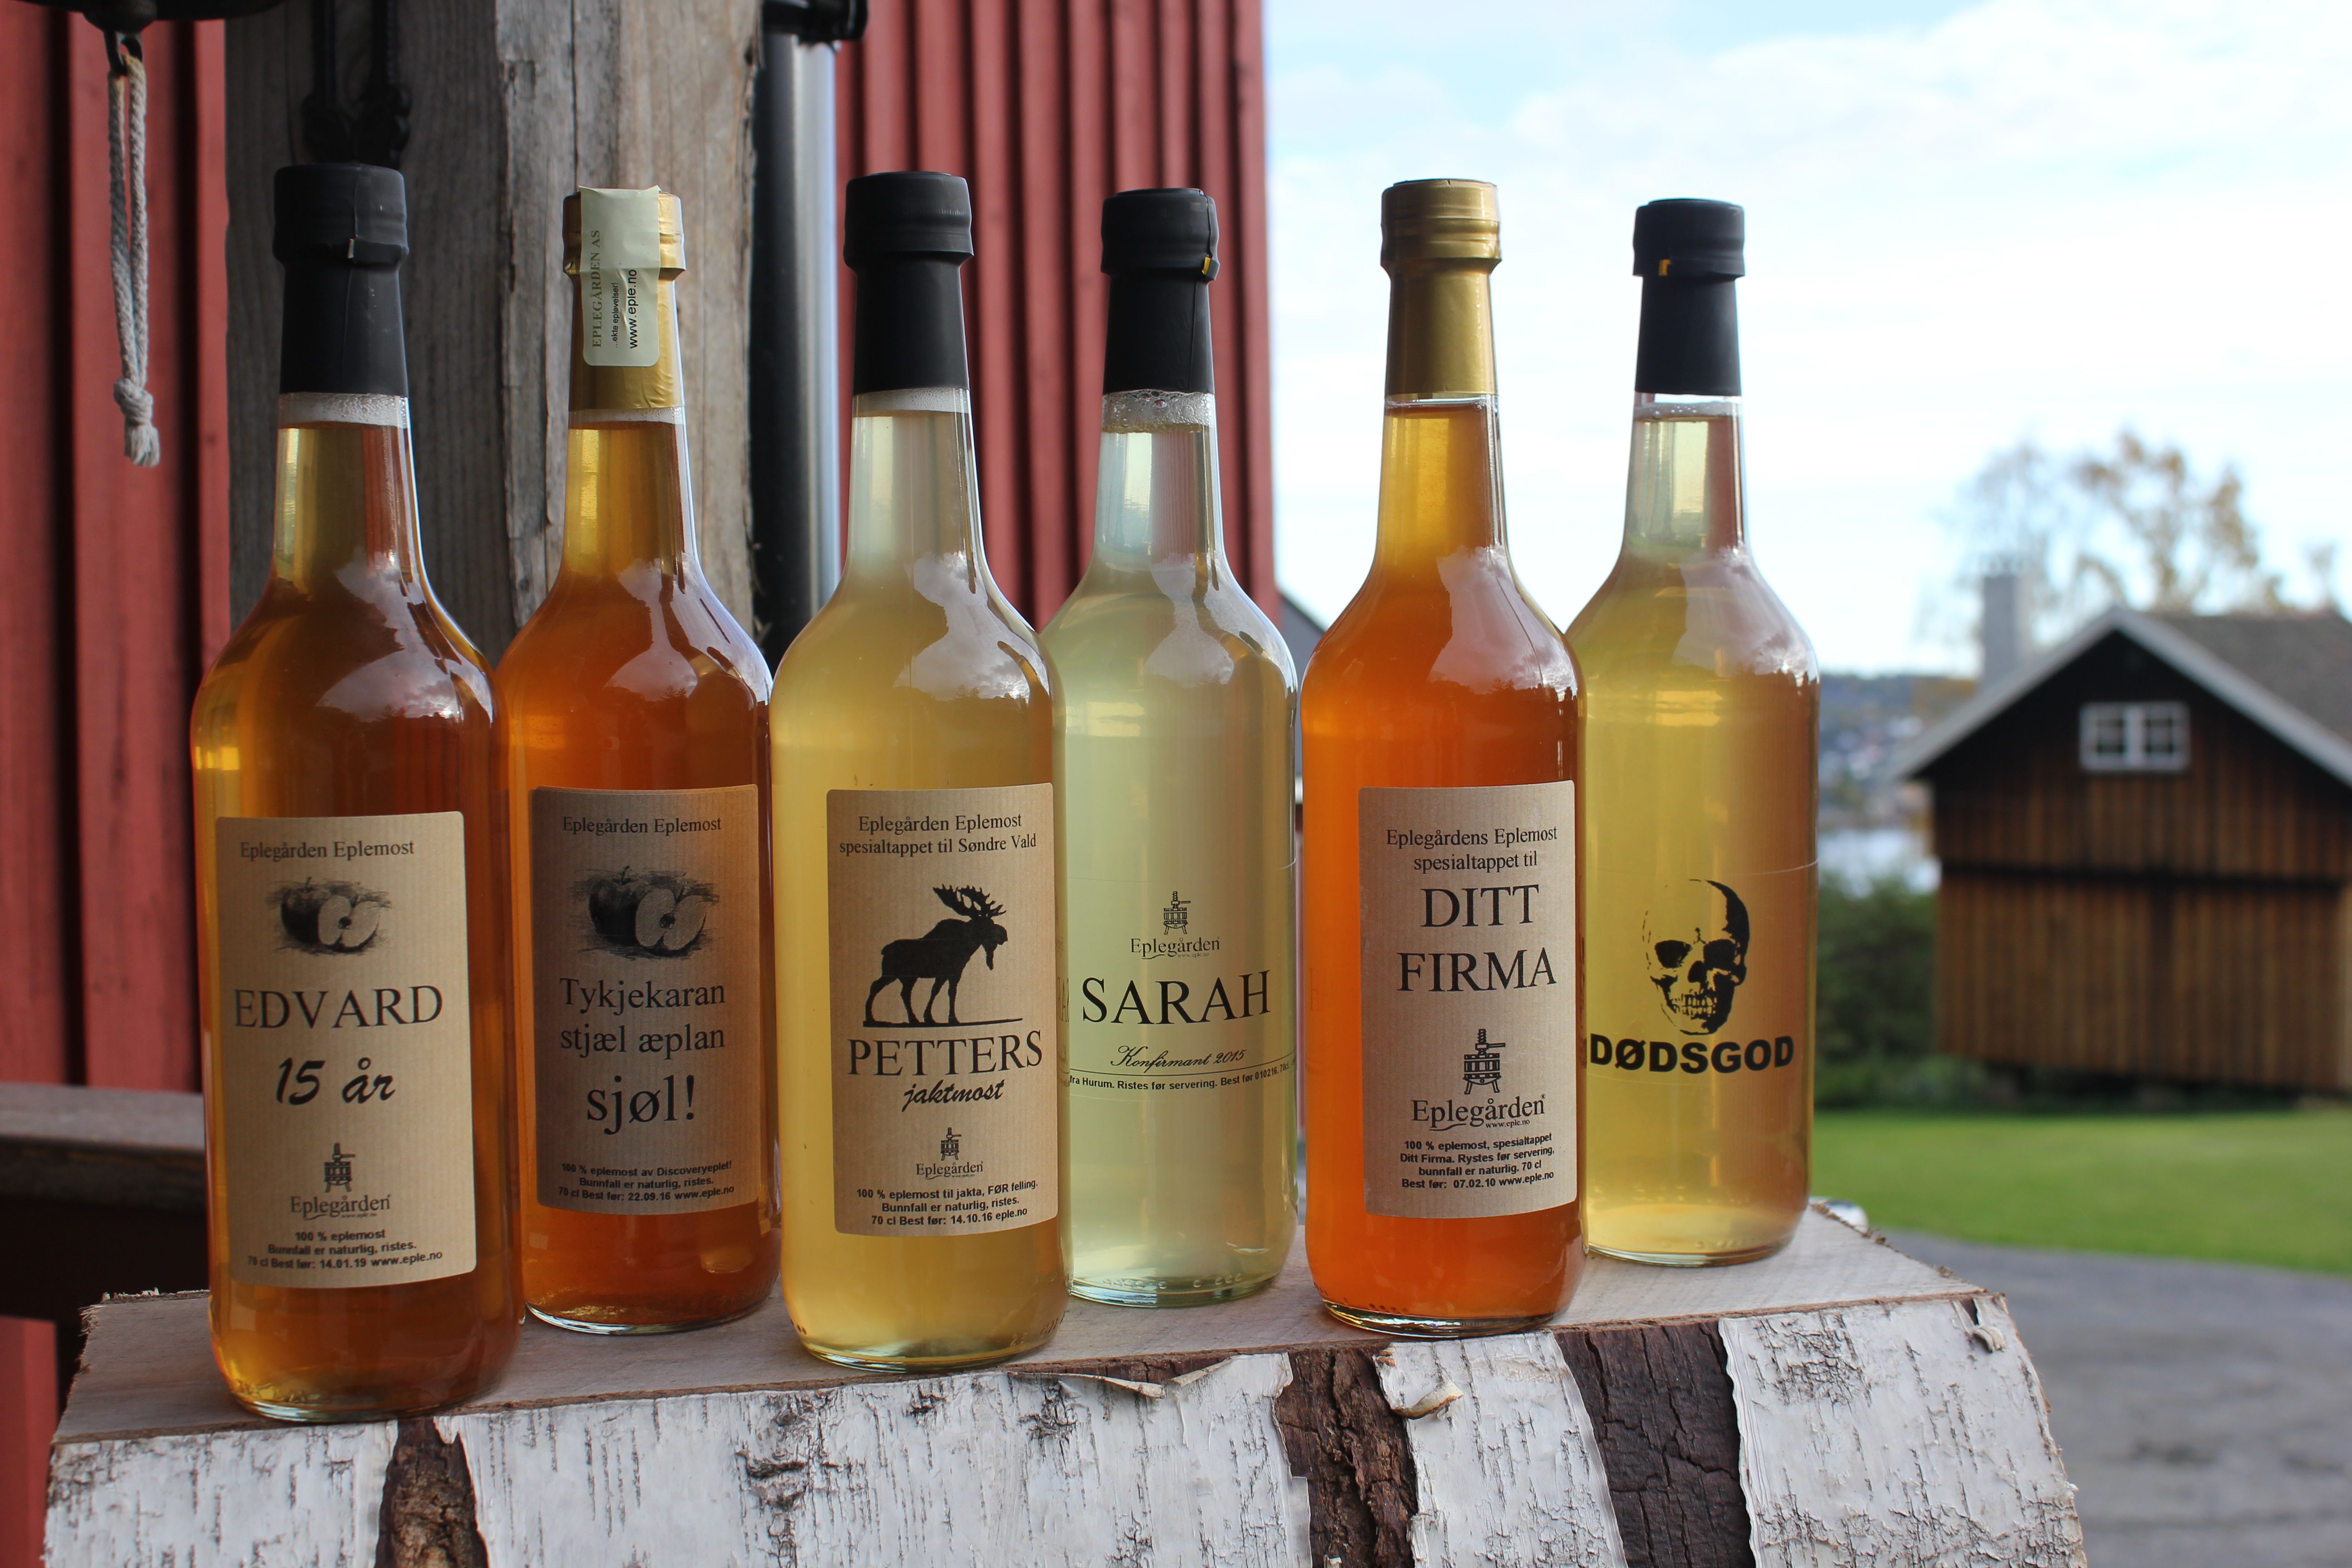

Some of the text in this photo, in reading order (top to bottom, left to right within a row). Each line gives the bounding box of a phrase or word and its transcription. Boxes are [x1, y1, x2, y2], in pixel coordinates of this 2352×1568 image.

[590, 230, 602, 349] EPLEGÅRDEN AS
[611, 283, 620, 323] eplevelser!
[627, 269, 639, 349] www.eple.no
[563, 816, 721, 836] Eplegården Eplemost
[859, 813, 1022, 835] Eplegården Eplemost
[840, 833, 1037, 858] spesialtappet til Søndre Vald
[1387, 826, 1557, 849] Eplegårdens Eplemost
[240, 840, 414, 862] Eplegården Eplemost
[1414, 850, 1537, 874] spesialtappet til
[1420, 884, 1539, 927] DITT
[1131, 937, 1220, 959] Eplegården
[1396, 947, 1557, 992] FIRMA
[234, 985, 442, 1029] EDVARD
[559, 978, 726, 1016] Tykjekaran
[1082, 970, 1270, 1024] SARAH
[560, 1023, 726, 1060] stjæl æplan
[847, 1029, 1043, 1076] PETTERS
[1110, 1045, 1247, 1073] Konfirmant 2015
[1590, 1033, 1794, 1074] DØDSGOD
[275, 1057, 396, 1105] 15 år
[1070, 1075, 1080, 1084] fra
[1083, 1077, 1115, 1088] Hurum.
[1117, 1080, 1148, 1090] Ristes
[1152, 1080, 1166, 1090] før
[1169, 1079, 1217, 1090] servering.
[1220, 1075, 1240, 1086] Best
[1242, 1073, 1253, 1082] før
[587, 1074, 695, 1135] sjøl!
[902, 1079, 1005, 1112] jaktmost
[1411, 1094, 1545, 1131] Eplegården
[1485, 1118, 1530, 1129] www.eple.no
[1404, 1132, 1552, 1152] 100 % eplemost, spesialtappet
[562, 1160, 732, 1179] 100 % eplemost av Discoveryeplet!
[1400, 1153, 1418, 1163] Ditt
[1421, 1154, 1455, 1163] Firma.
[1458, 1153, 1494, 1165] Rystes
[1497, 1152, 1510, 1161] før
[1419, 1160, 1542, 1176] bunnfall er naturlig. 70 cl
[916, 1161, 983, 1180] Eplegården
[1402, 1171, 1554, 1189] Best før: 07.02.10 www.eple.no
[559, 1185, 735, 1201] 70 cl Best før: 22.09.16 www.eple.no
[580, 1176, 714, 1190] Bunnfall er naturlig, ristes.
[857, 1180, 1038, 1201] 100 % eplemost til jakta, FØR felling.
[290, 1195, 390, 1220] Eplegården
[882, 1196, 1019, 1213] Bunnfall er naturlig, ristes.
[872, 1207, 1027, 1226] 70 cl Best før: 14.10.16 eple.no
[296, 1229, 385, 1243] 100 % eplemost
[268, 1241, 416, 1256] Bunnfall er naturlig, ristes.
[271, 1258, 294, 1269] Best
[319, 1257, 367, 1269] 14.01.19
[370, 1251, 443, 1267] www.eple.no
